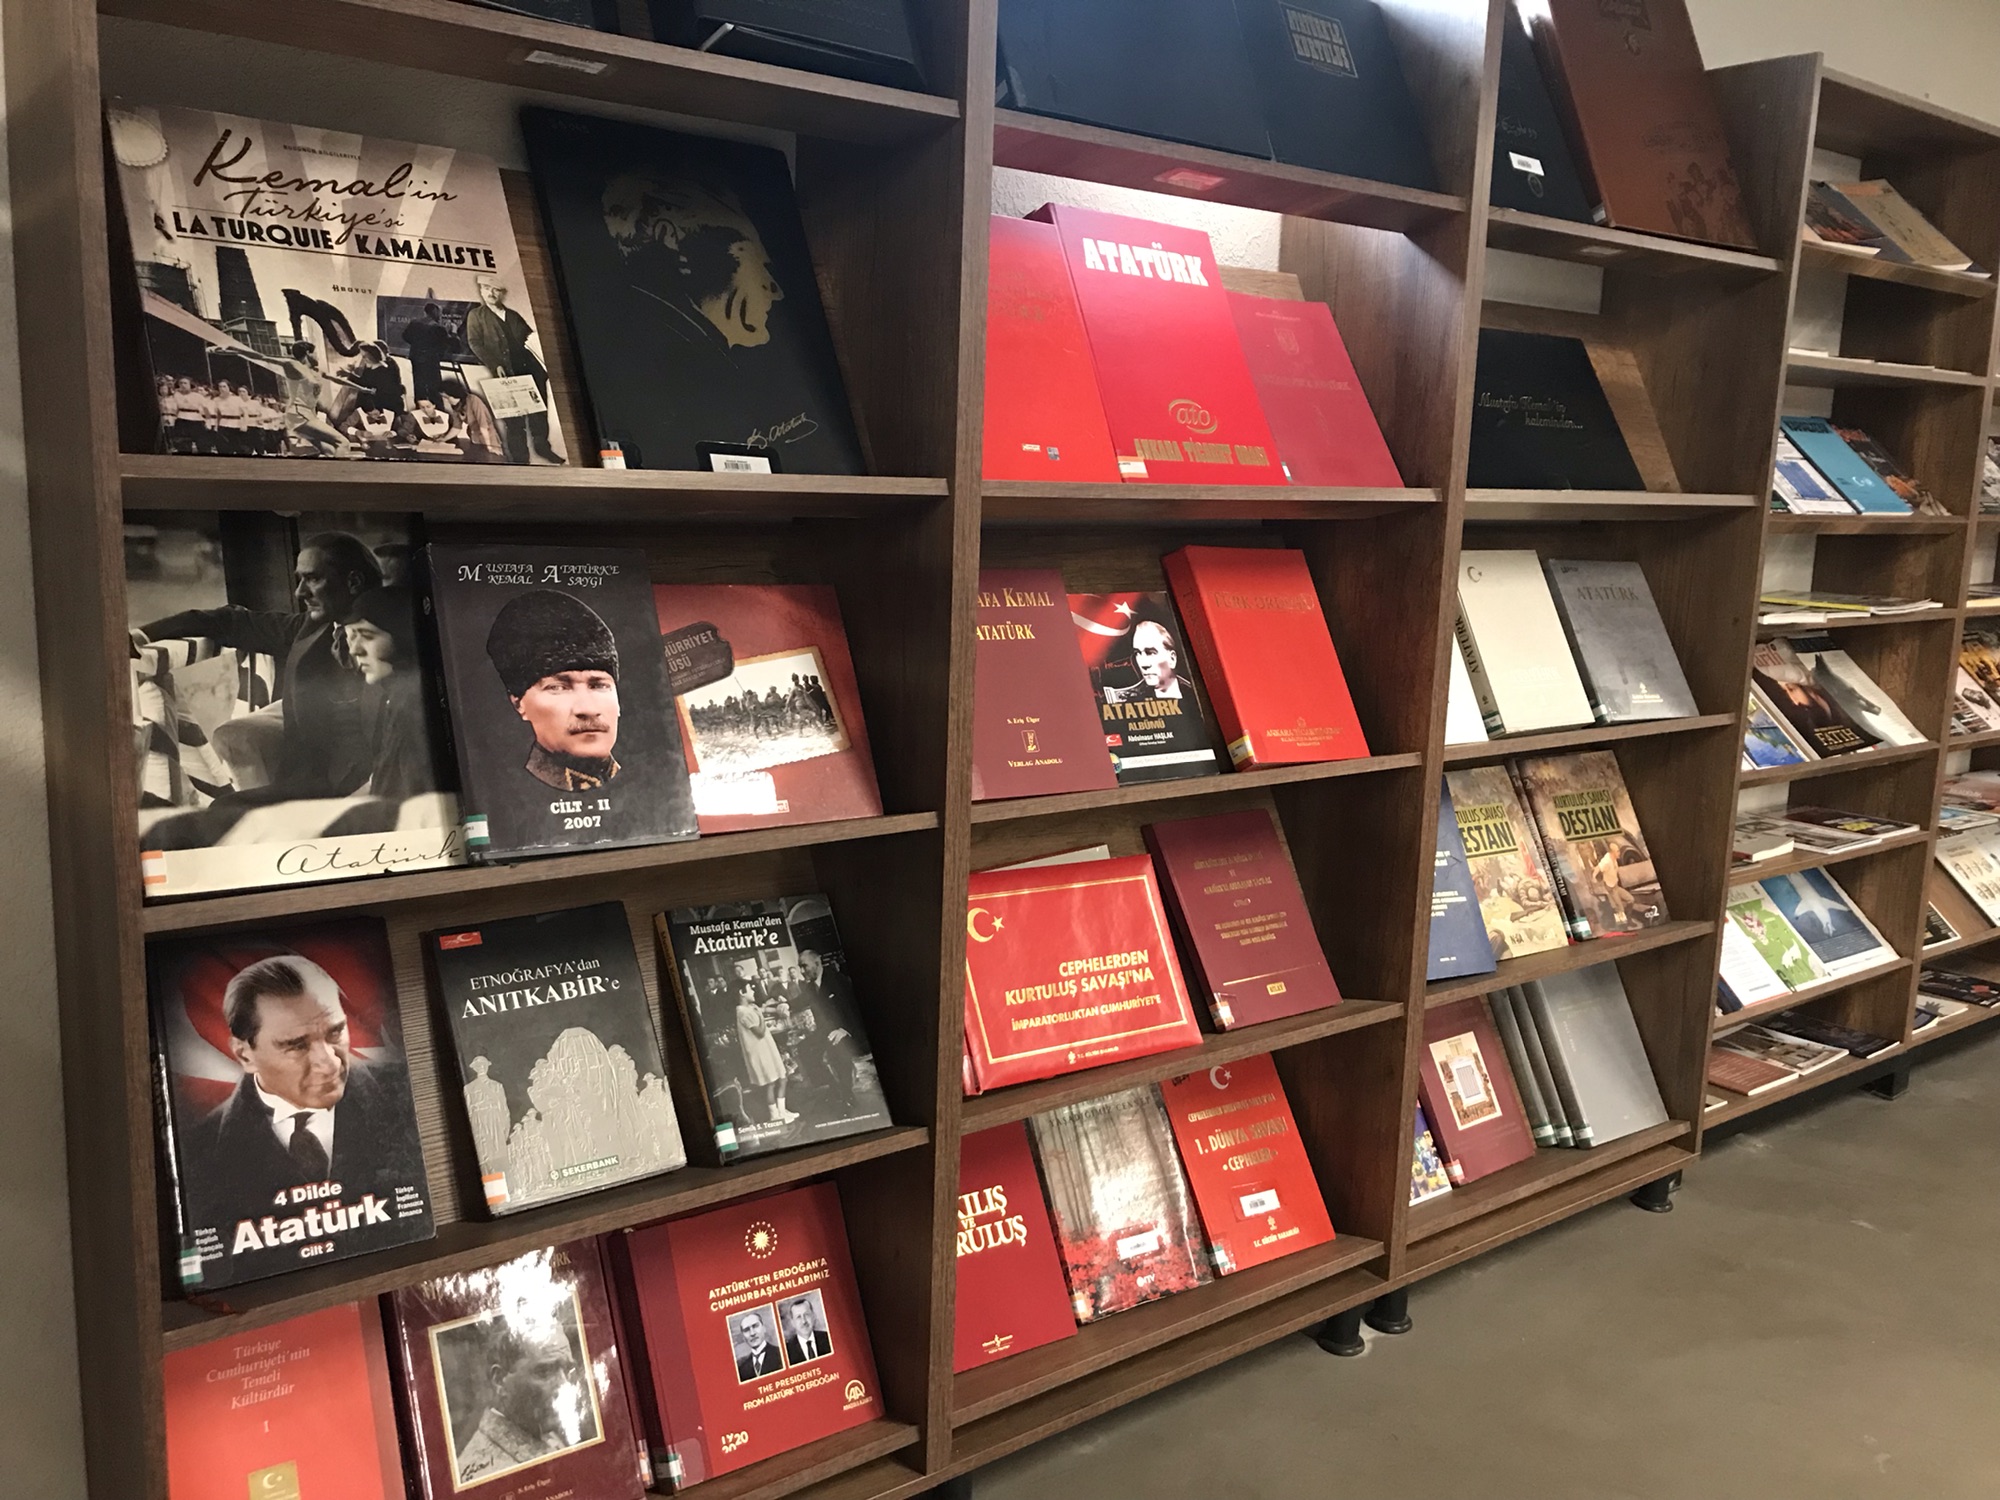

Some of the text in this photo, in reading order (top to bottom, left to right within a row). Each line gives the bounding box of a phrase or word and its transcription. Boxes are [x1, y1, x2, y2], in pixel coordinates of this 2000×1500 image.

[193, 128, 459, 203] Kemal'in
[223, 187, 405, 246] Türkiye'si
[172, 211, 496, 269] LA TURQUIE KAMÂLISTE
[1082, 236, 1209, 287] ATATÜRK
[1176, 405, 1211, 426] ato
[487, 575, 603, 588] KEMAL SAYGI
[976, 620, 1036, 641] ATATÜRK
[668, 653, 692, 675] ÜSÜ
[1102, 697, 1183, 721] ATATÜRK
[1128, 717, 1166, 731] ALBÜMÜ
[550, 798, 583, 814] CİLT
[563, 815, 601, 830] 2007
[1558, 805, 1621, 836] DESTANI
[689, 916, 782, 935] Mustafa Kemal'den
[694, 928, 779, 955] Atatürk'e
[470, 957, 601, 991] ETNOĞRAFYA'dan
[1059, 950, 1149, 977] CEPHELERDEN
[461, 974, 621, 1019] ANITKABİR'e
[1005, 967, 1154, 1006] KURTULUŞ SAVAŞI'NA
[1011, 995, 1162, 1031] İMPARATORLUKTAN CUMHURİYET'E
[1195, 1138, 1209, 1155] 1.
[1208, 1128, 1249, 1151] DÜNYA
[274, 1183, 343, 1206] 4 Dilde
[232, 1194, 392, 1255] Atatürk
[960, 1216, 977, 1230] VE
[300, 1242, 335, 1258] Cilt 2
[708, 1257, 828, 1300] ATATÜRK'TEN ERDOĞAN'A
[710, 1269, 830, 1312] CUMHURBAŞKANLARIMIZ
[233, 1339, 282, 1360] Türkiye
[206, 1347, 310, 1383] Cumhuriyeti'nin
[241, 1368, 281, 1390] Temeli
[743, 1372, 840, 1411] FROM ATATÜRK TO ERDOĞAN
[757, 1367, 822, 1395] THE PRESIDENTS
[231, 1383, 295, 1410] Kültürdür
